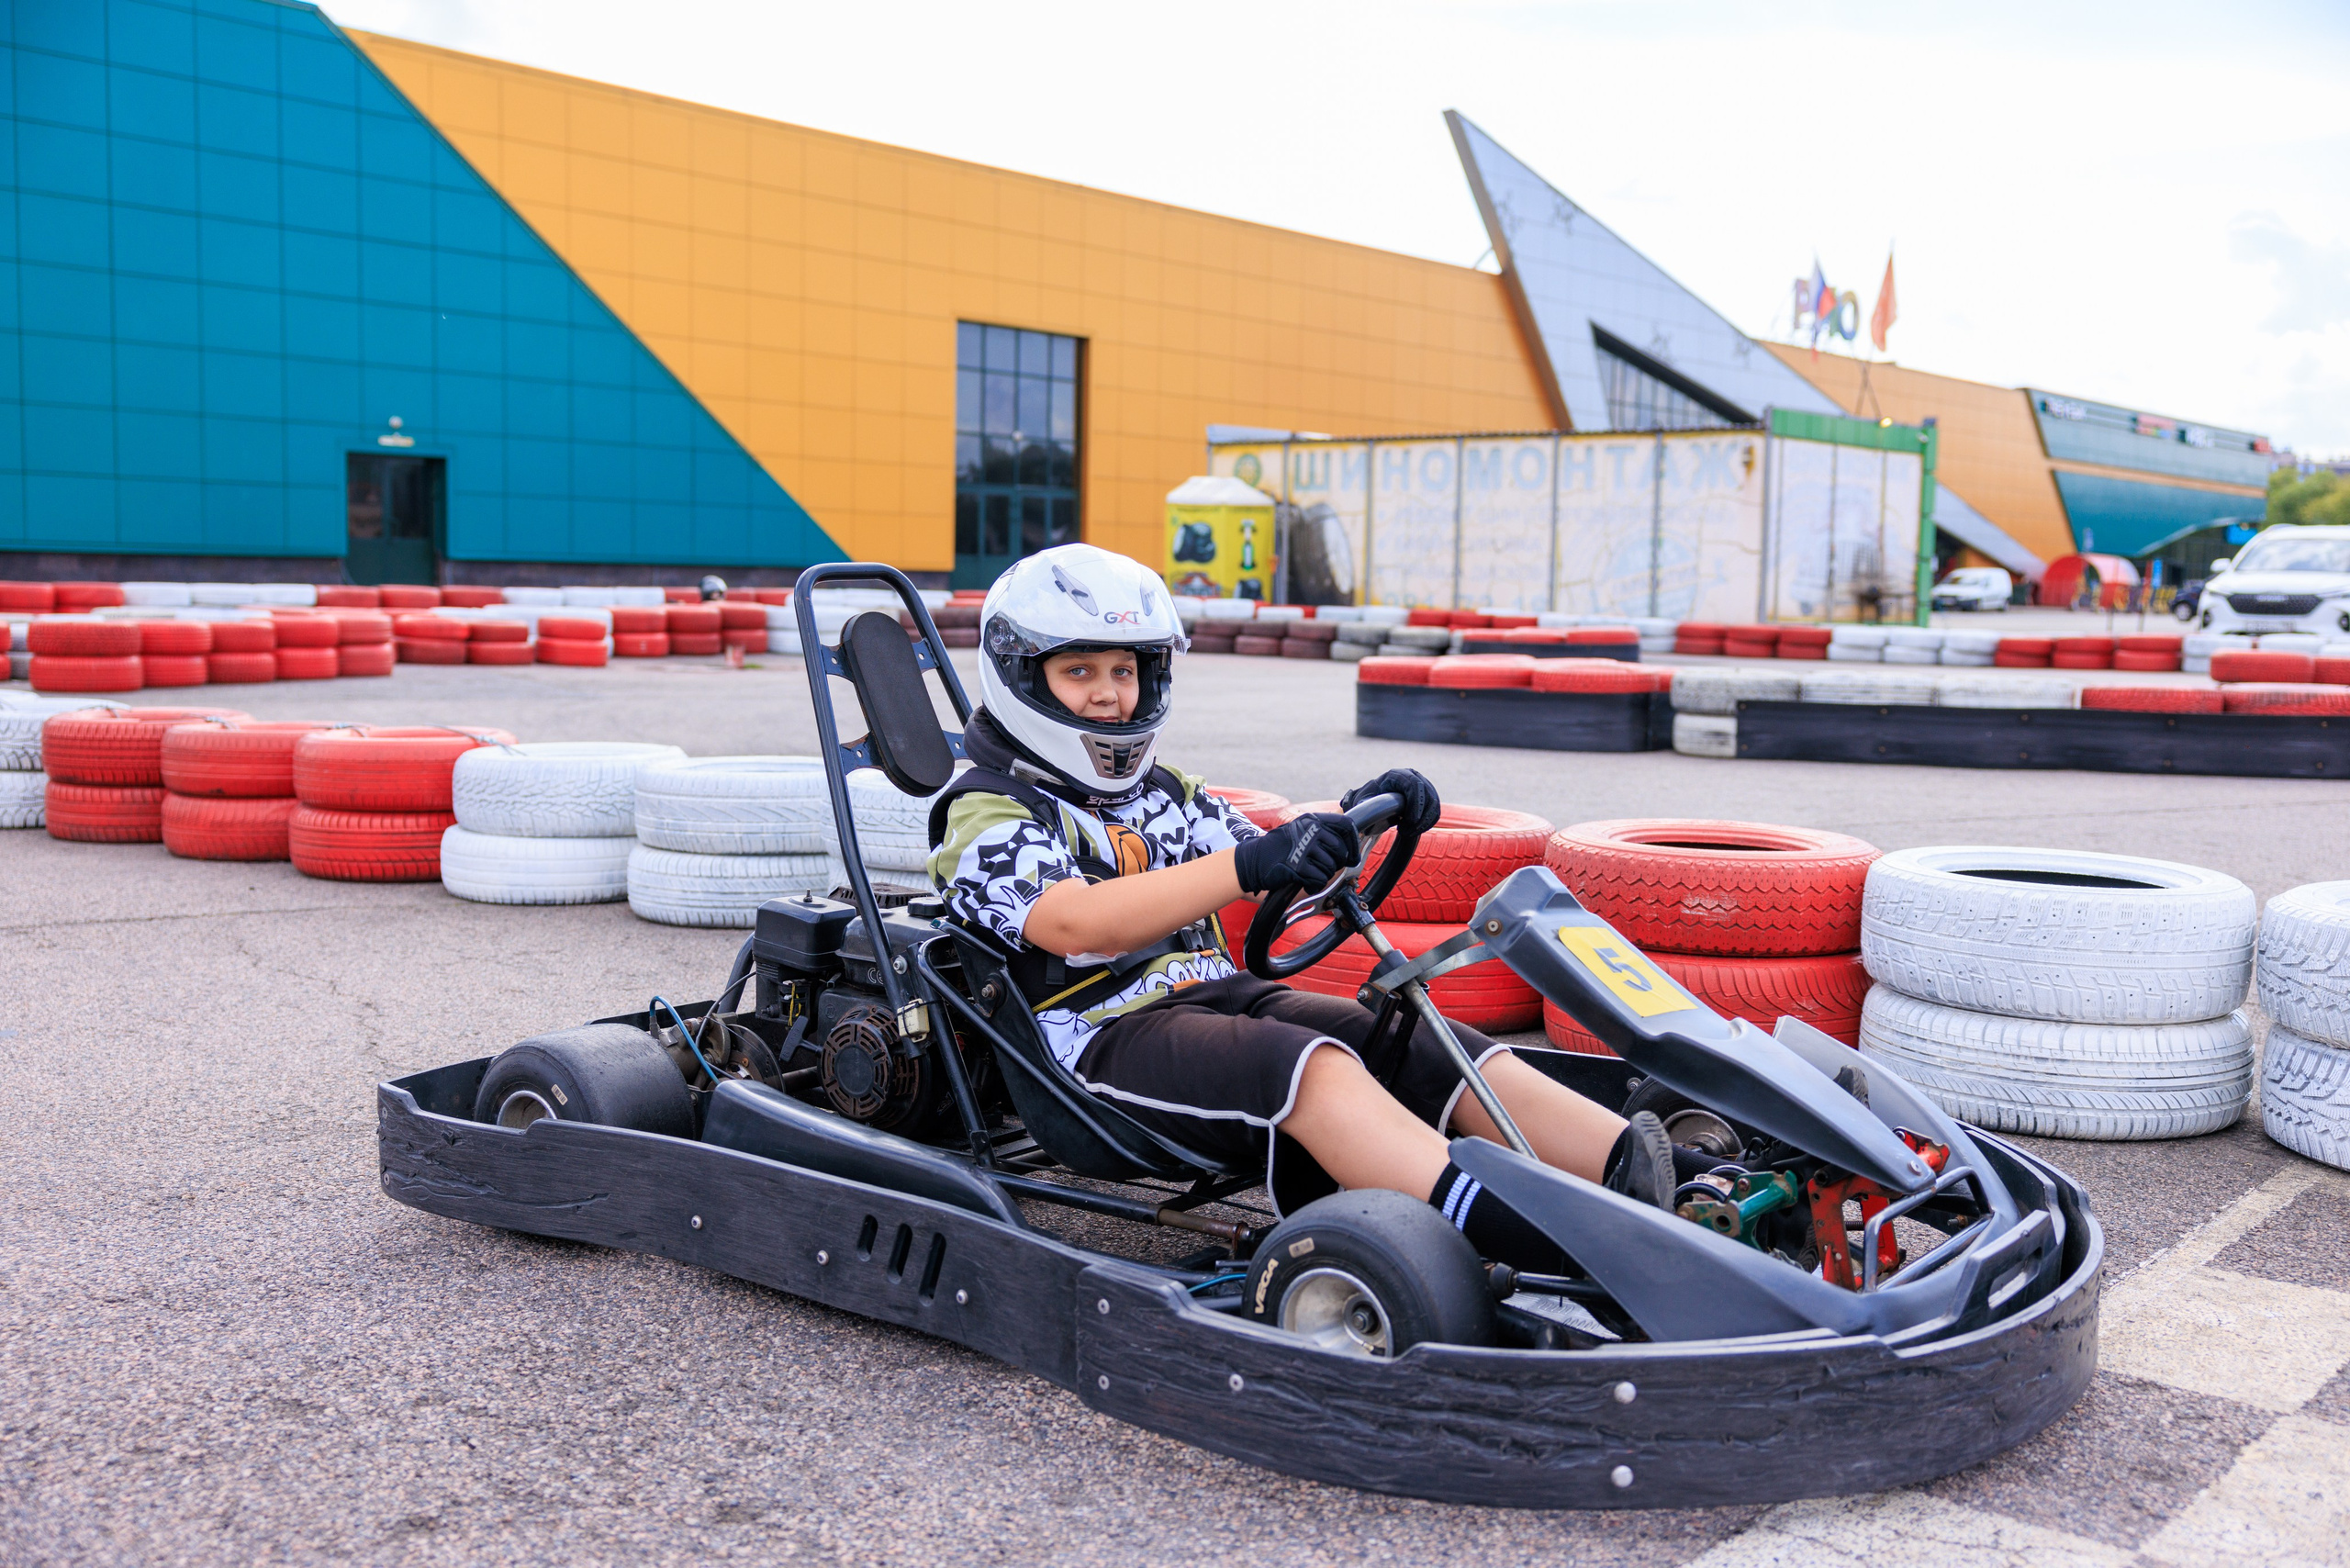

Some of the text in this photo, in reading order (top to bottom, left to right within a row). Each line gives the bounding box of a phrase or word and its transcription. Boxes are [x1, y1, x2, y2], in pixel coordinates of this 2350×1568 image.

[1293, 442, 1740, 492] ШИНОМОНТАЖ
[1103, 610, 1141, 624] GXT
[1290, 823, 1321, 865] THOR
[1592, 946, 1653, 992] 5
[1254, 1258, 1280, 1314] VEGA
